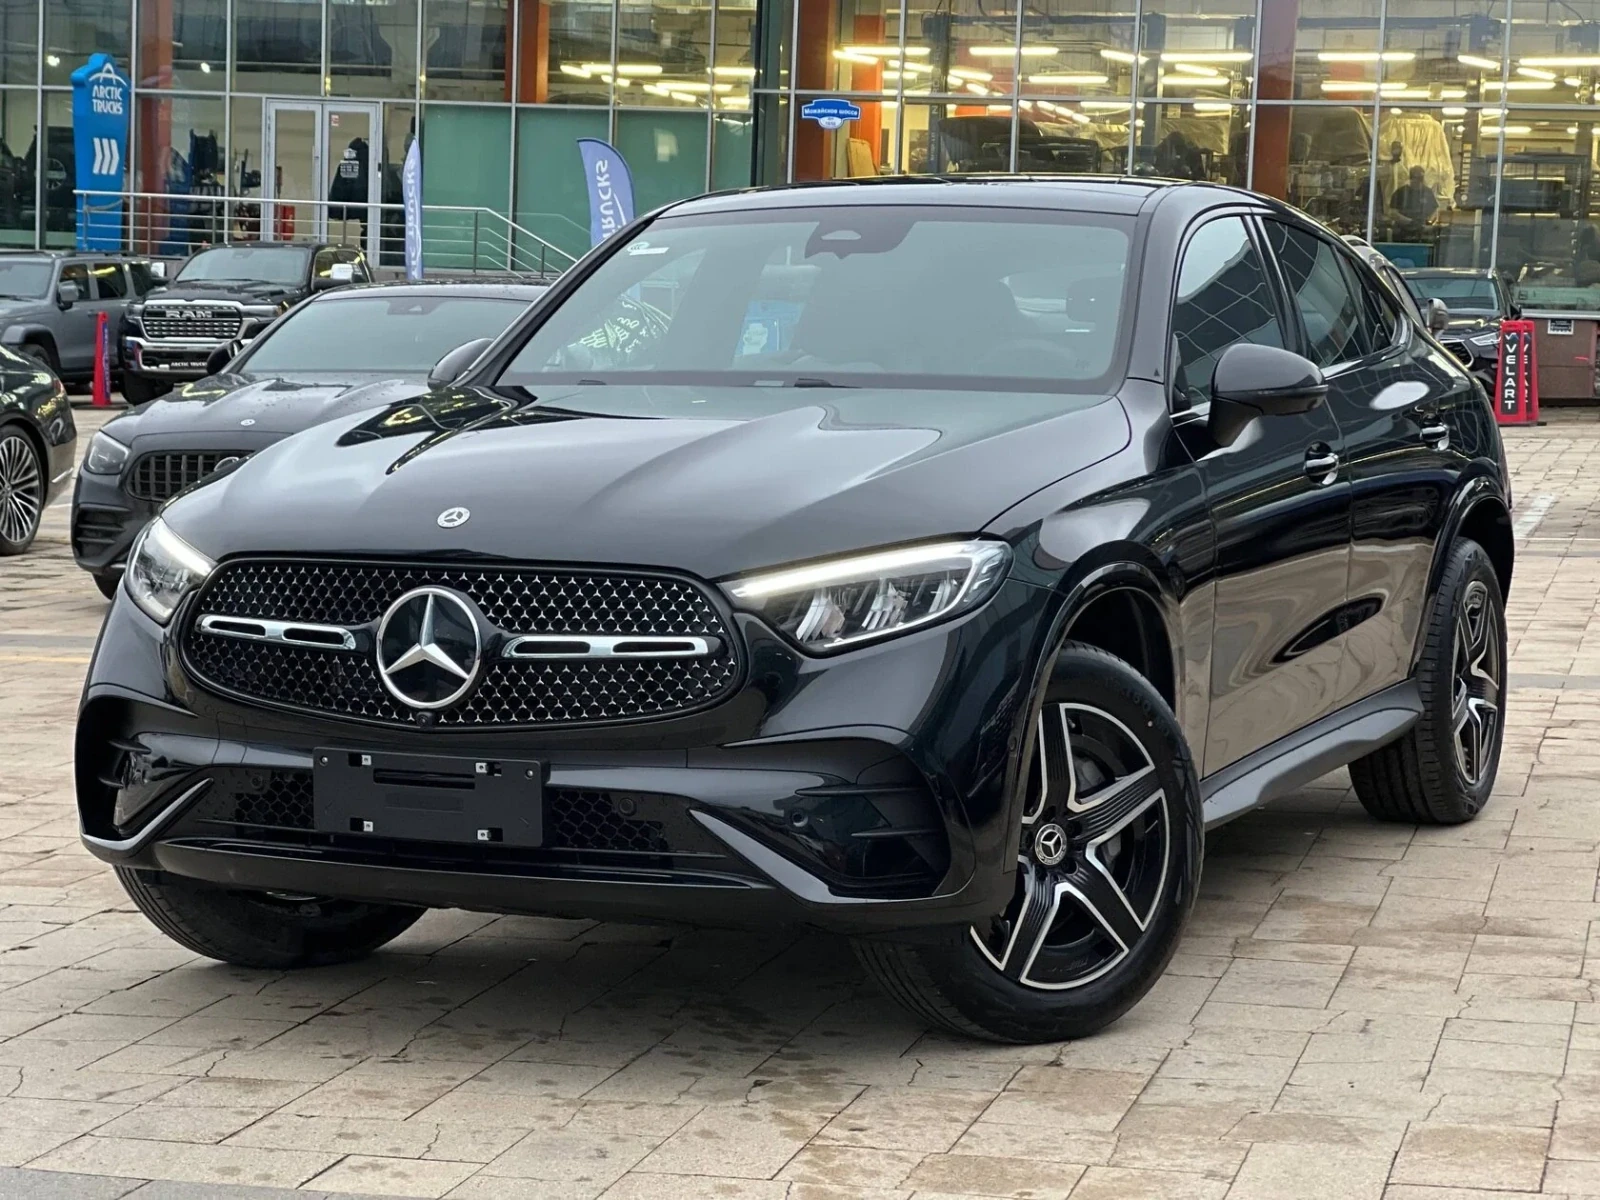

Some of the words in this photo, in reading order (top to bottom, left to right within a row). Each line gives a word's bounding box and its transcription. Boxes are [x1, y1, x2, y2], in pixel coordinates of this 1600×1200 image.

[92, 84, 123, 101] ARCTIC
[92, 98, 123, 114] TRUCKS
[166, 310, 212, 318] RAM
[1504, 344, 1517, 409] VELART
